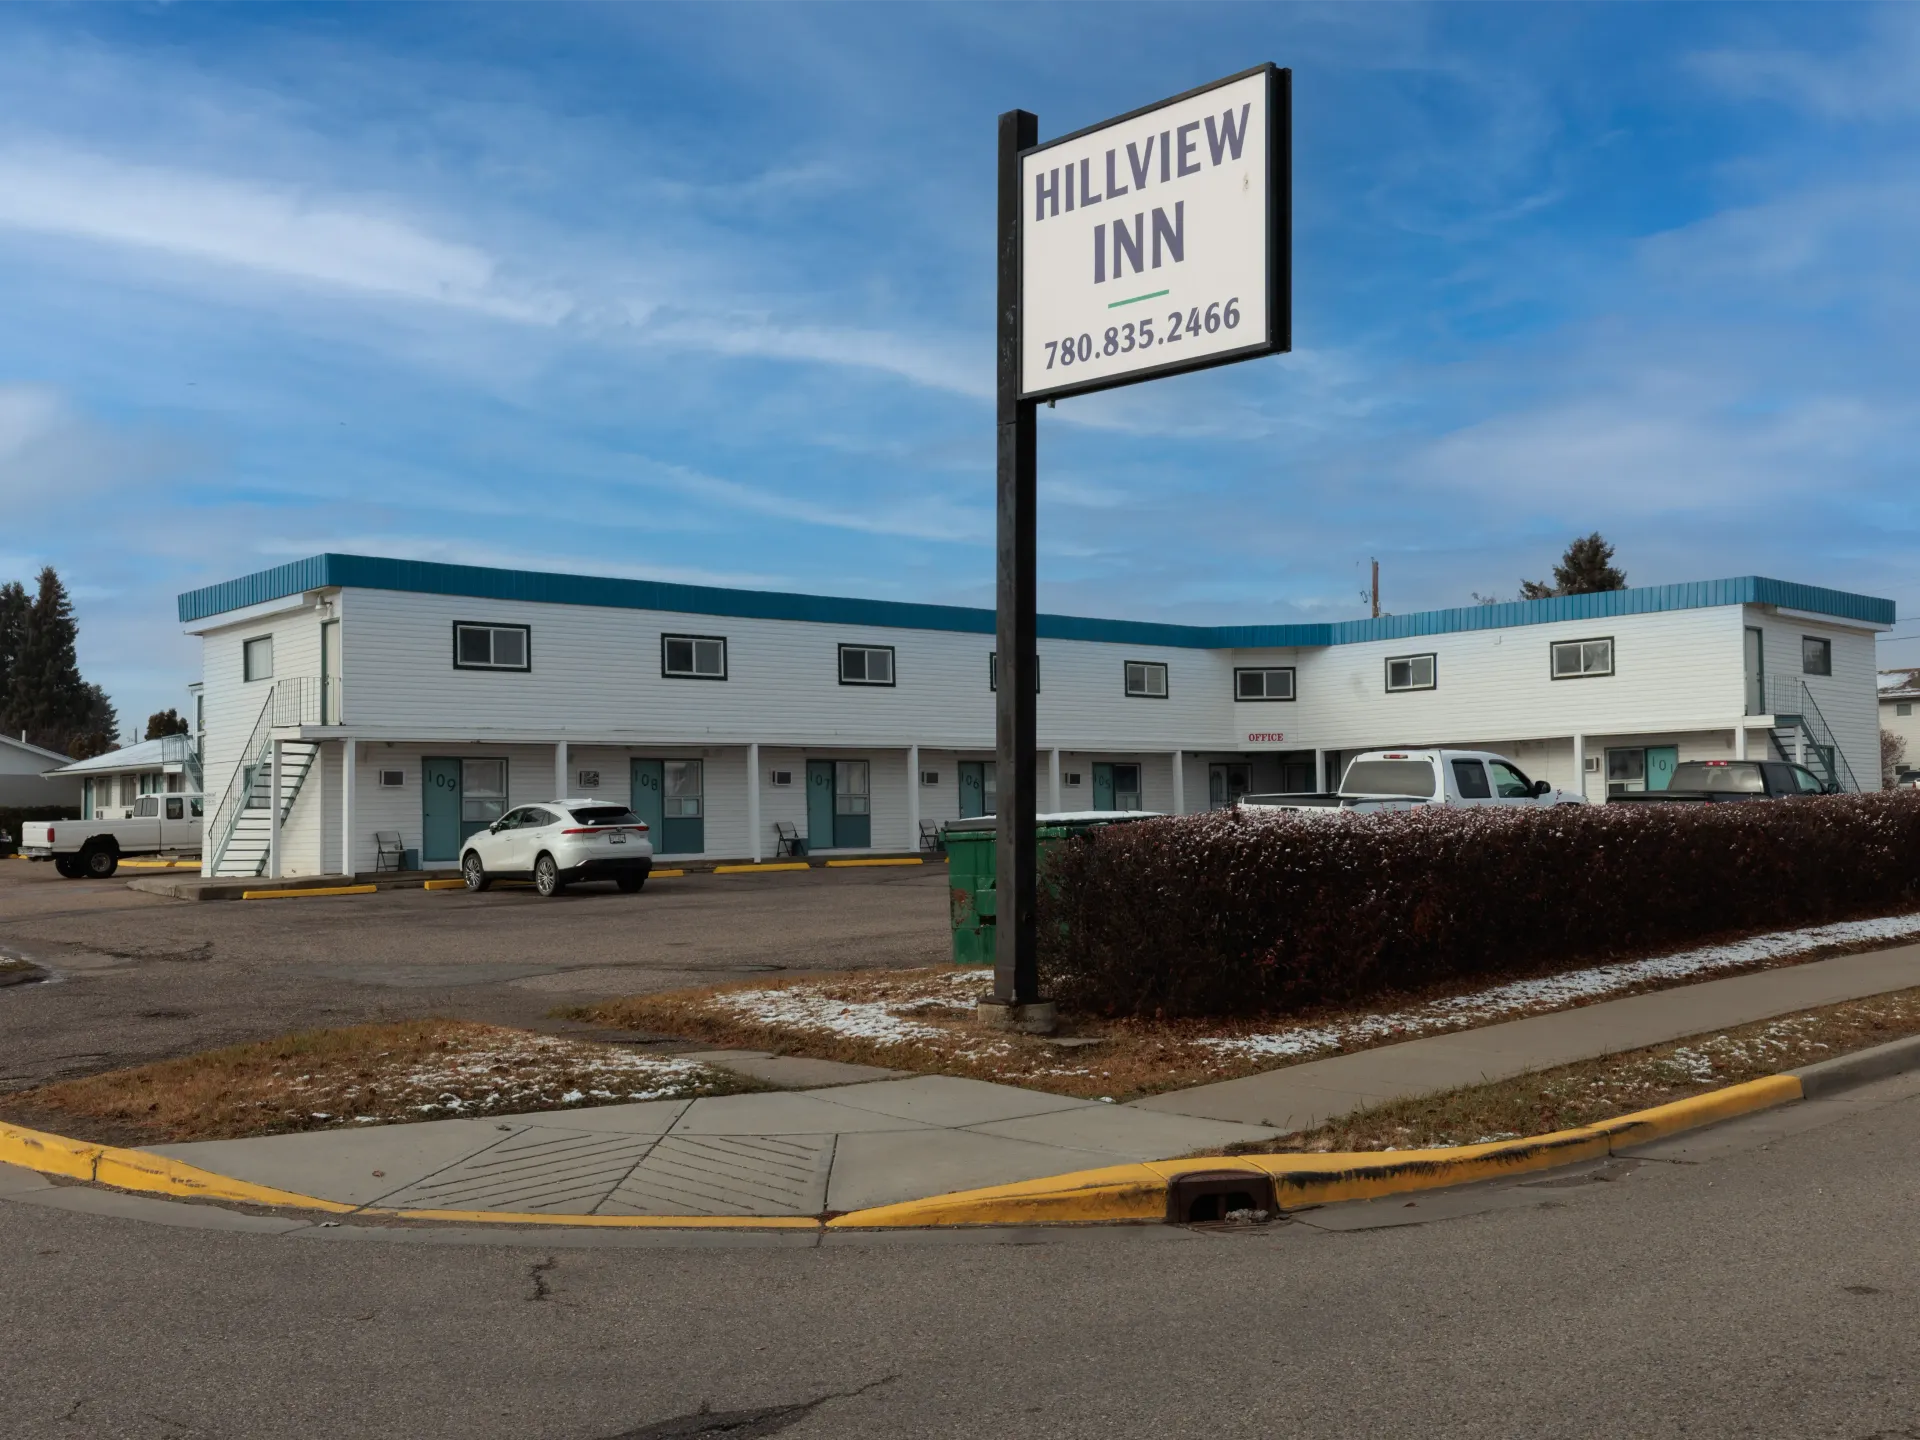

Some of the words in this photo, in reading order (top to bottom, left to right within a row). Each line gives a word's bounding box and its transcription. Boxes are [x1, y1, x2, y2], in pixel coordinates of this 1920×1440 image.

[1035, 102, 1251, 222] HILLVIEW
[1094, 200, 1184, 284] INN
[1044, 297, 1241, 370] 780.835.2466
[1248, 732, 1284, 742] OFFICE
[428, 769, 456, 792] 109
[634, 769, 658, 791] 108
[810, 769, 830, 791] 107
[961, 770, 980, 789] 106
